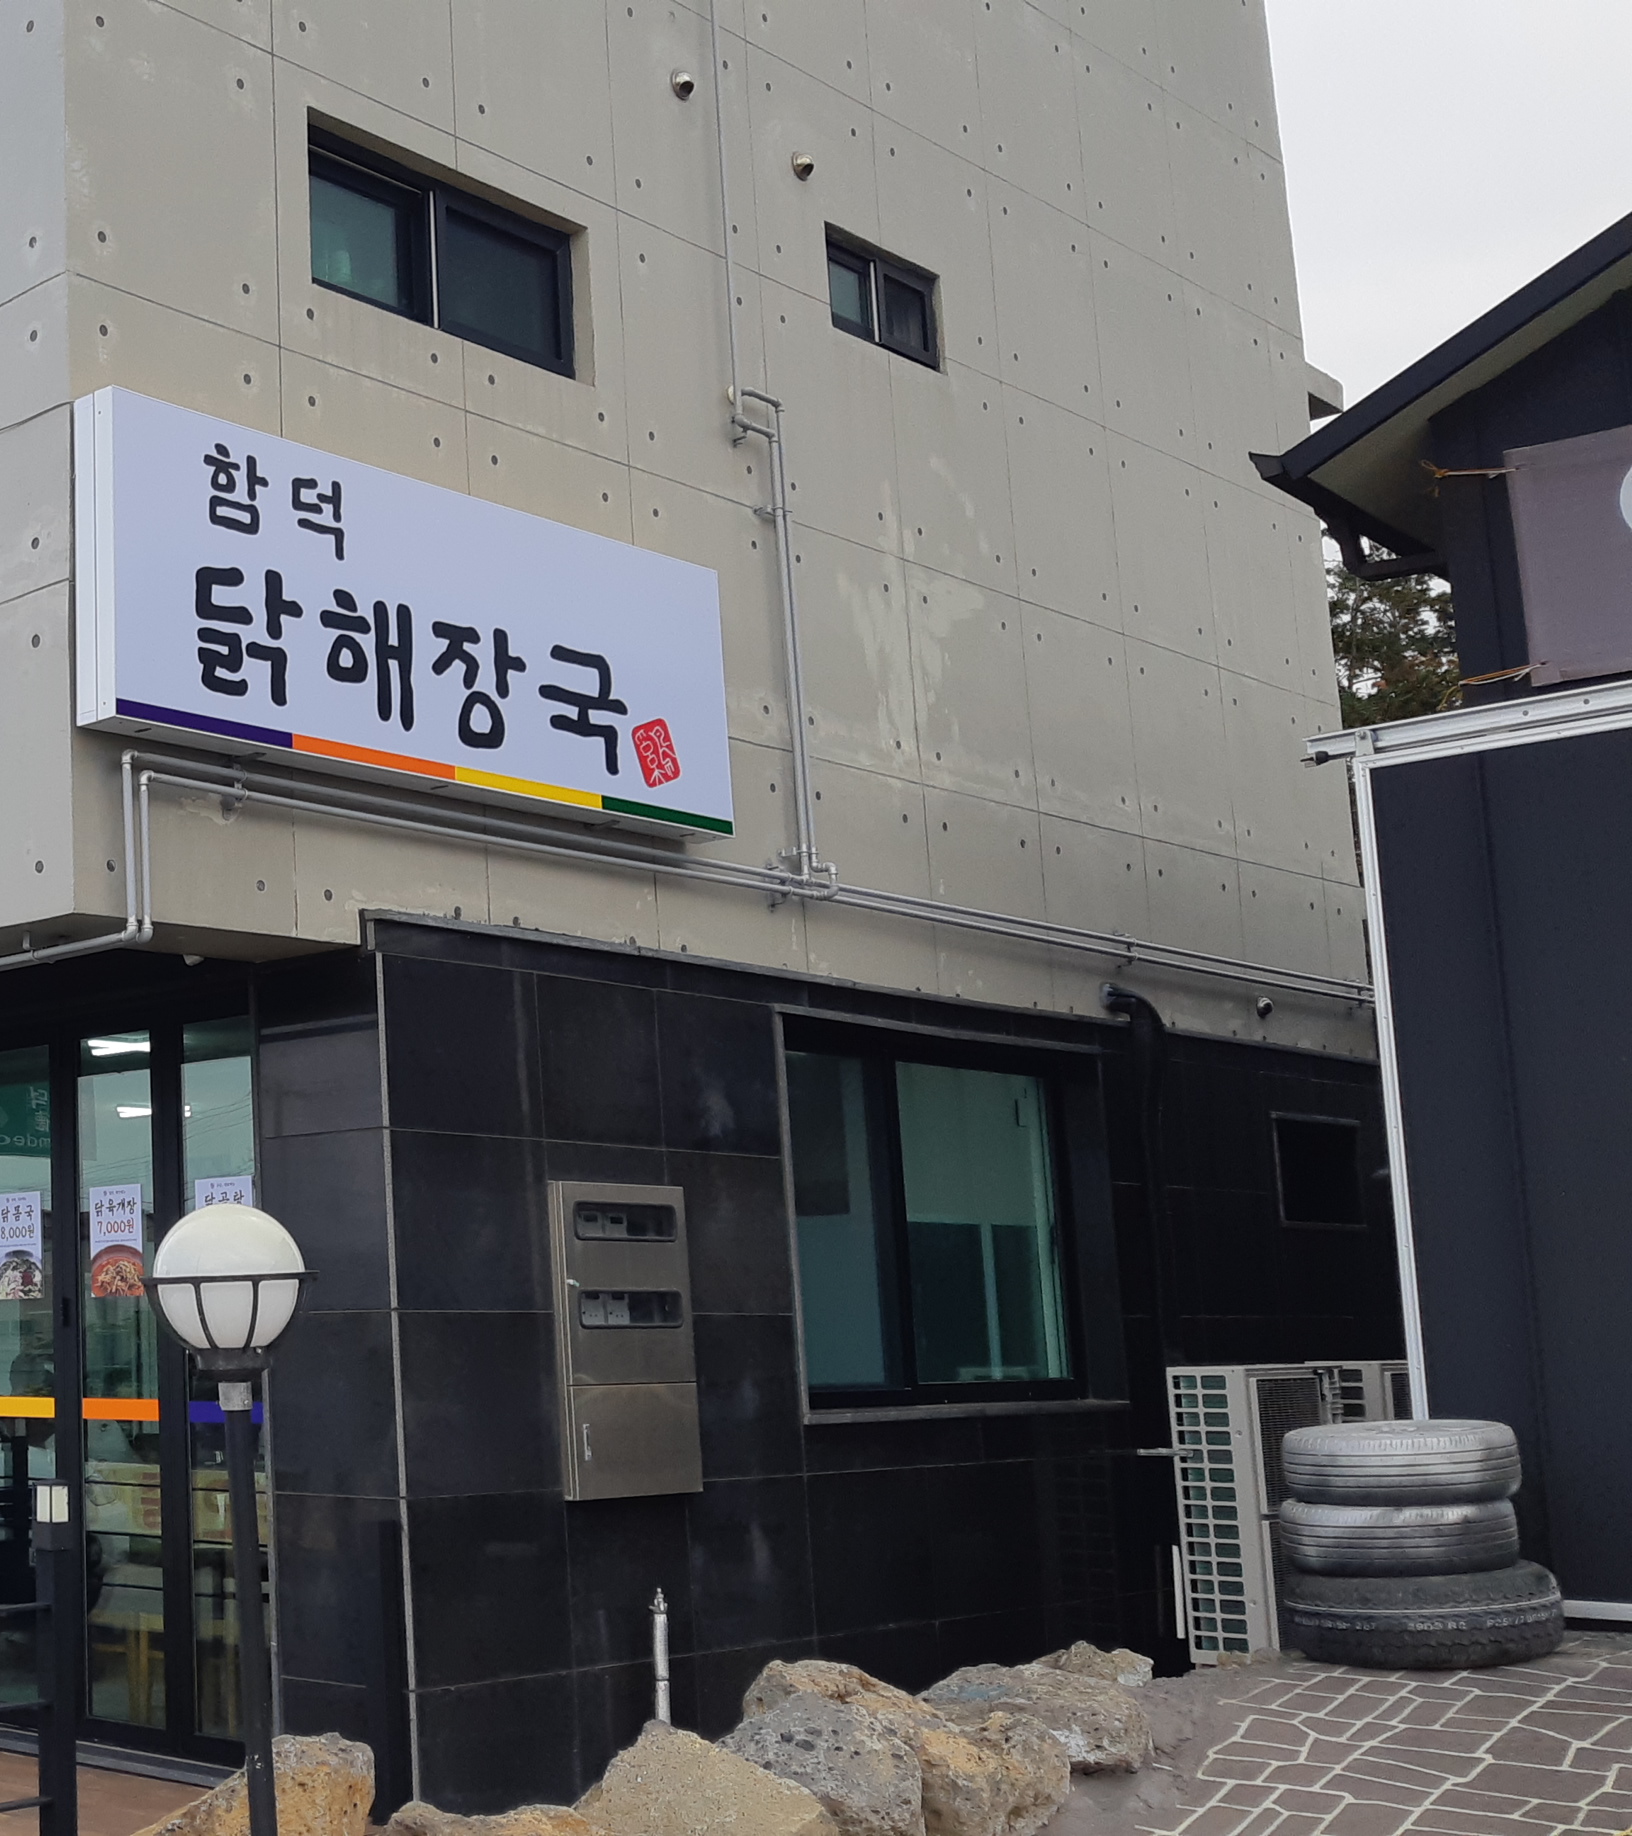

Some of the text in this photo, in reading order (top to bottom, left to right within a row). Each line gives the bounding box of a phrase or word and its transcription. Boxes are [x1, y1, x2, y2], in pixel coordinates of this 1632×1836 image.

[203, 442, 346, 561] 함덕
[194, 566, 629, 777] 닭해장국
[0, 1204, 35, 1223] 닭몸국
[94, 1196, 137, 1217] 닭육개장
[0, 1223, 35, 1242] 8,000원
[97, 1217, 135, 1236] 7,000원
